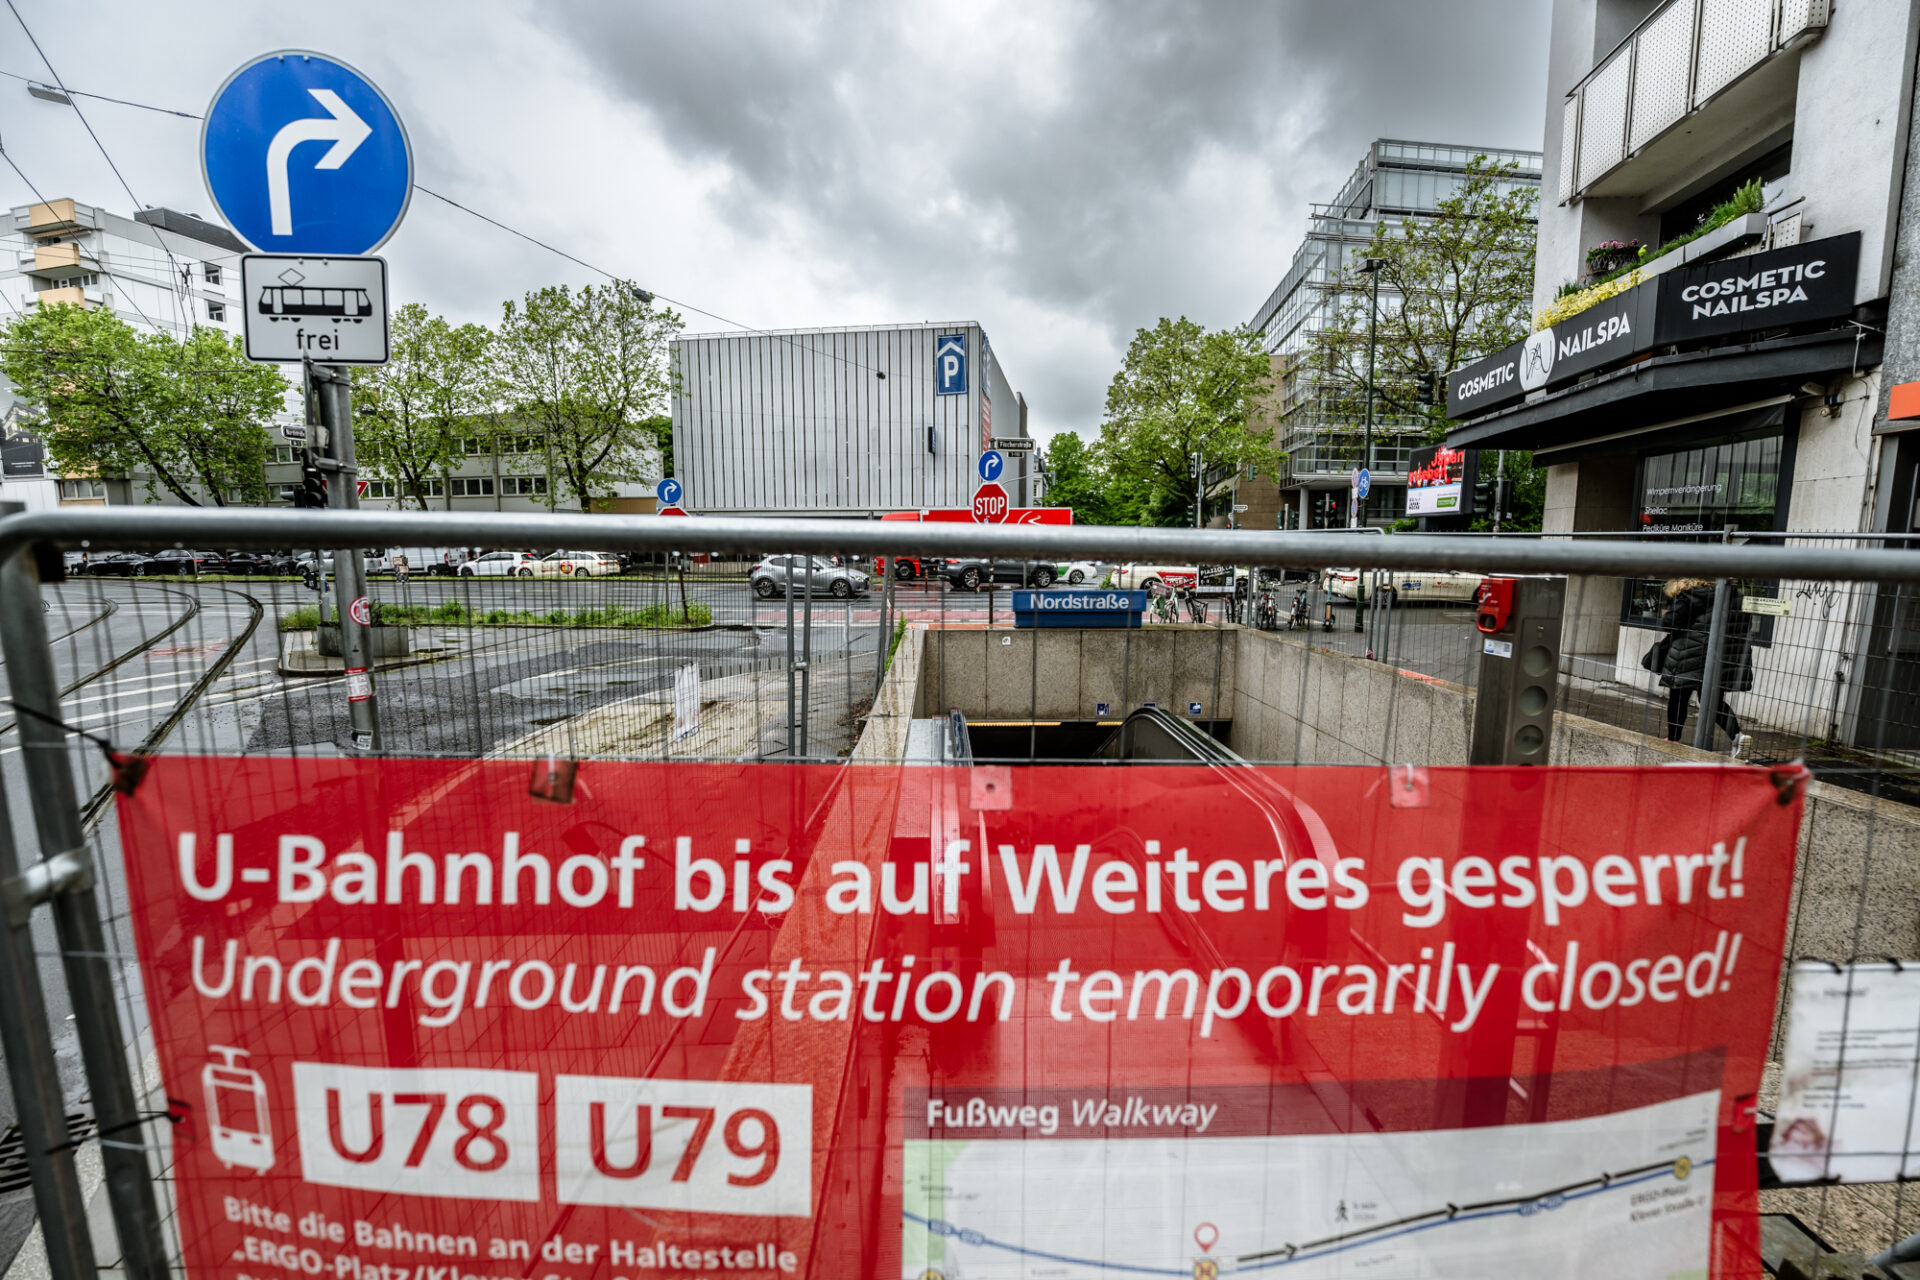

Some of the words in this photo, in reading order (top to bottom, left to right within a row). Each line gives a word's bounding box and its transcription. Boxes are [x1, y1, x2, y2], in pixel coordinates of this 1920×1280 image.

[1682, 260, 1826, 303] COSMETIC
[1692, 286, 1809, 321] NAILSPA
[296, 327, 340, 351] frei
[1458, 361, 1515, 401] COSMETIC
[1558, 311, 1631, 362] NAILSPA
[943, 355, 960, 389] P
[1431, 450, 1464, 467] Japan
[975, 496, 1005, 516] STOP
[1646, 484, 1722, 496] Wimpernverlängerung
[1642, 524, 1670, 533] Pediküre
[1671, 522, 1704, 532] Maniküre
[1644, 506, 1668, 515] Shellac
[1030, 593, 1130, 610] Nordstraße
[178, 832, 645, 907] U-Bahnhof
[674, 836, 795, 913] bis
[825, 839, 971, 915] auf
[998, 839, 1370, 915] Weiteres
[1396, 836, 1747, 927] gesperrt!
[191, 936, 717, 1028] Underground
[736, 954, 1016, 1022] station
[1046, 940, 1500, 1038] temporarily
[1521, 930, 1742, 1013] closed!
[927, 1097, 1060, 1136] Fußweg
[1072, 1096, 1219, 1134] Walkway
[325, 1088, 511, 1172] U78
[589, 1100, 780, 1188] U79
[223, 1195, 291, 1233] Bitte
[299, 1211, 346, 1243] die
[353, 1219, 478, 1257] Bahnen
[488, 1237, 531, 1261] an
[541, 1233, 600, 1265] der
[609, 1238, 799, 1273] Haltestelle
